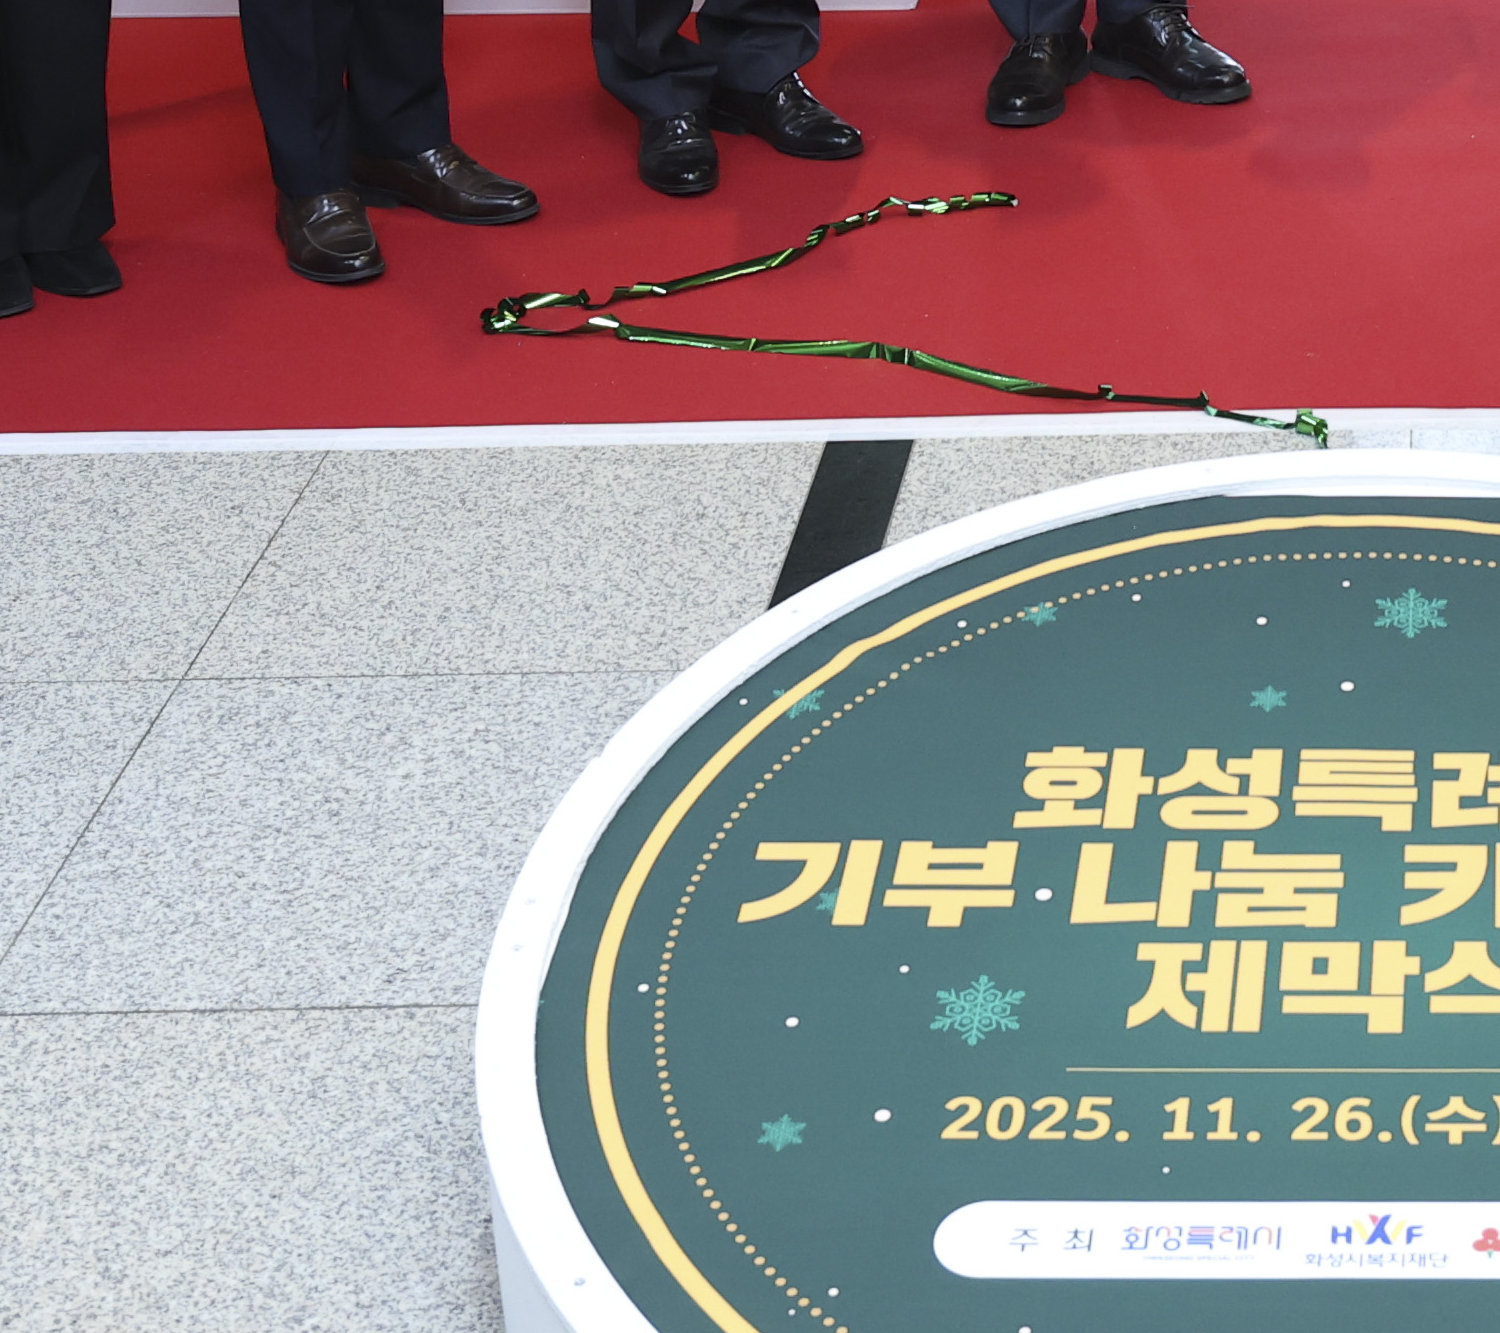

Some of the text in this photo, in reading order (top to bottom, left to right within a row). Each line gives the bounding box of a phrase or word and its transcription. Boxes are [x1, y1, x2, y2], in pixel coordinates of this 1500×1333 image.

[737, 839, 1019, 927] 기부
[1069, 840, 1345, 928] 나눔
[940, 1095, 1130, 1142] 2025.
[1162, 1097, 1261, 1142] 11.
[1120, 1225, 1281, 1251] 화성특례시
[1304, 1252, 1448, 1268] 화성시복지재단
